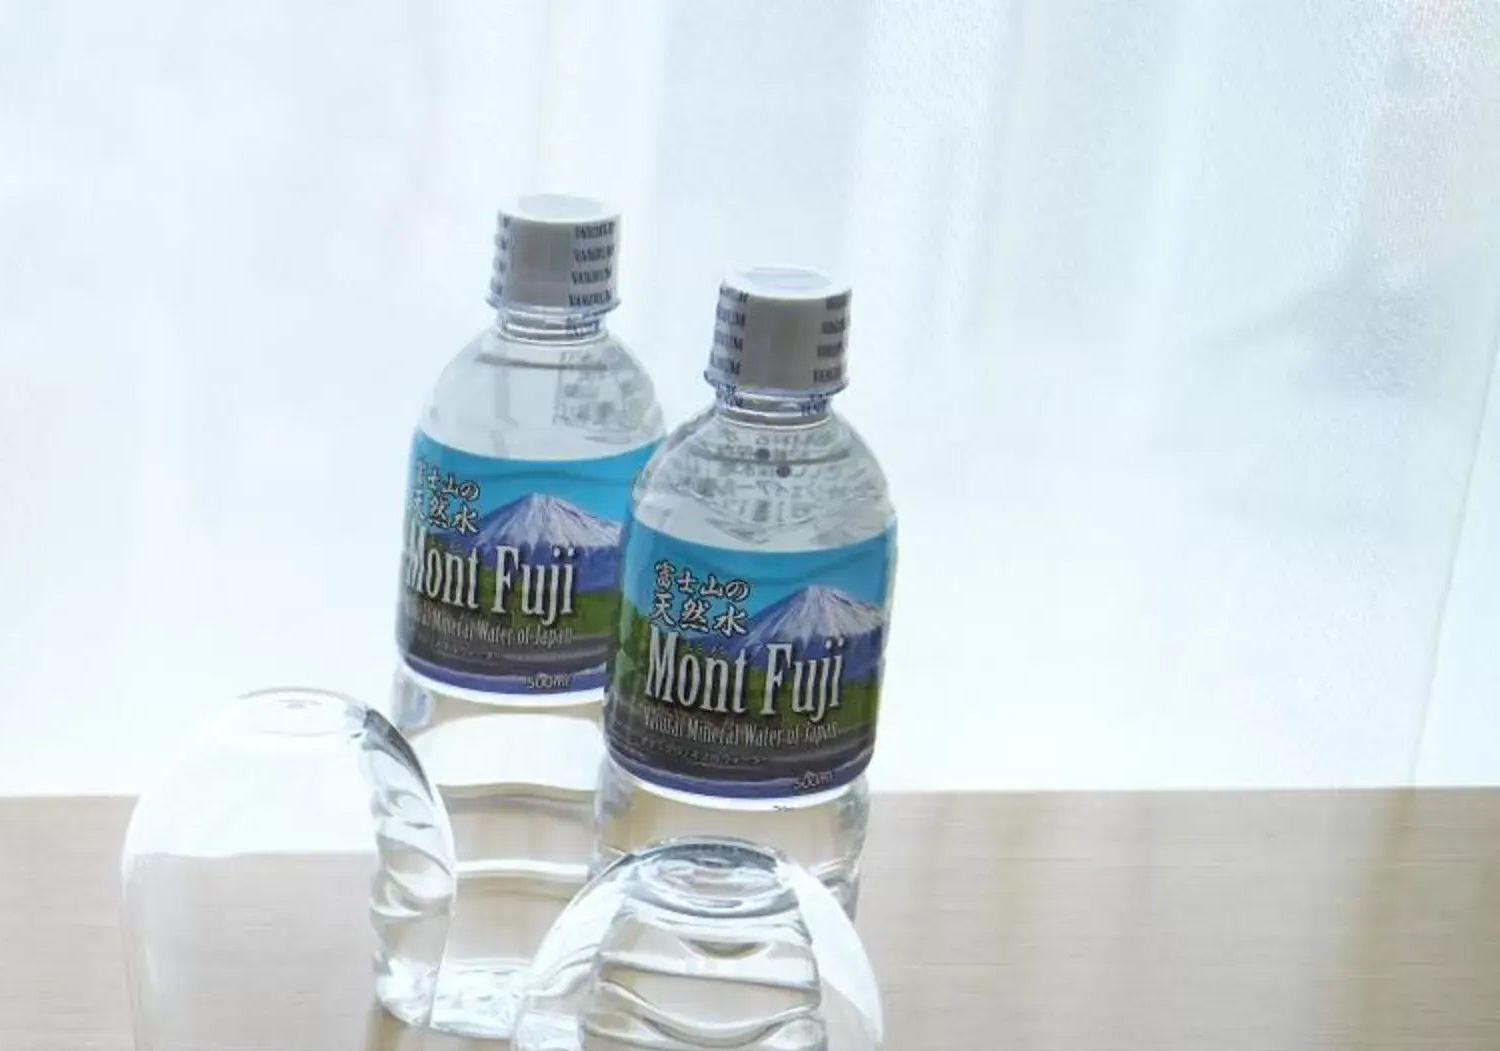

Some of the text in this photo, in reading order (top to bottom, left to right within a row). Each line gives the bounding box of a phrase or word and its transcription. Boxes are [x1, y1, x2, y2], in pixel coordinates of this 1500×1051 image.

[491, 545, 575, 625] Fuji
[653, 560, 749, 602] 富士山の
[651, 591, 749, 636] 天然水
[645, 624, 845, 722] Mont Fuji
[745, 723, 782, 749] Water
